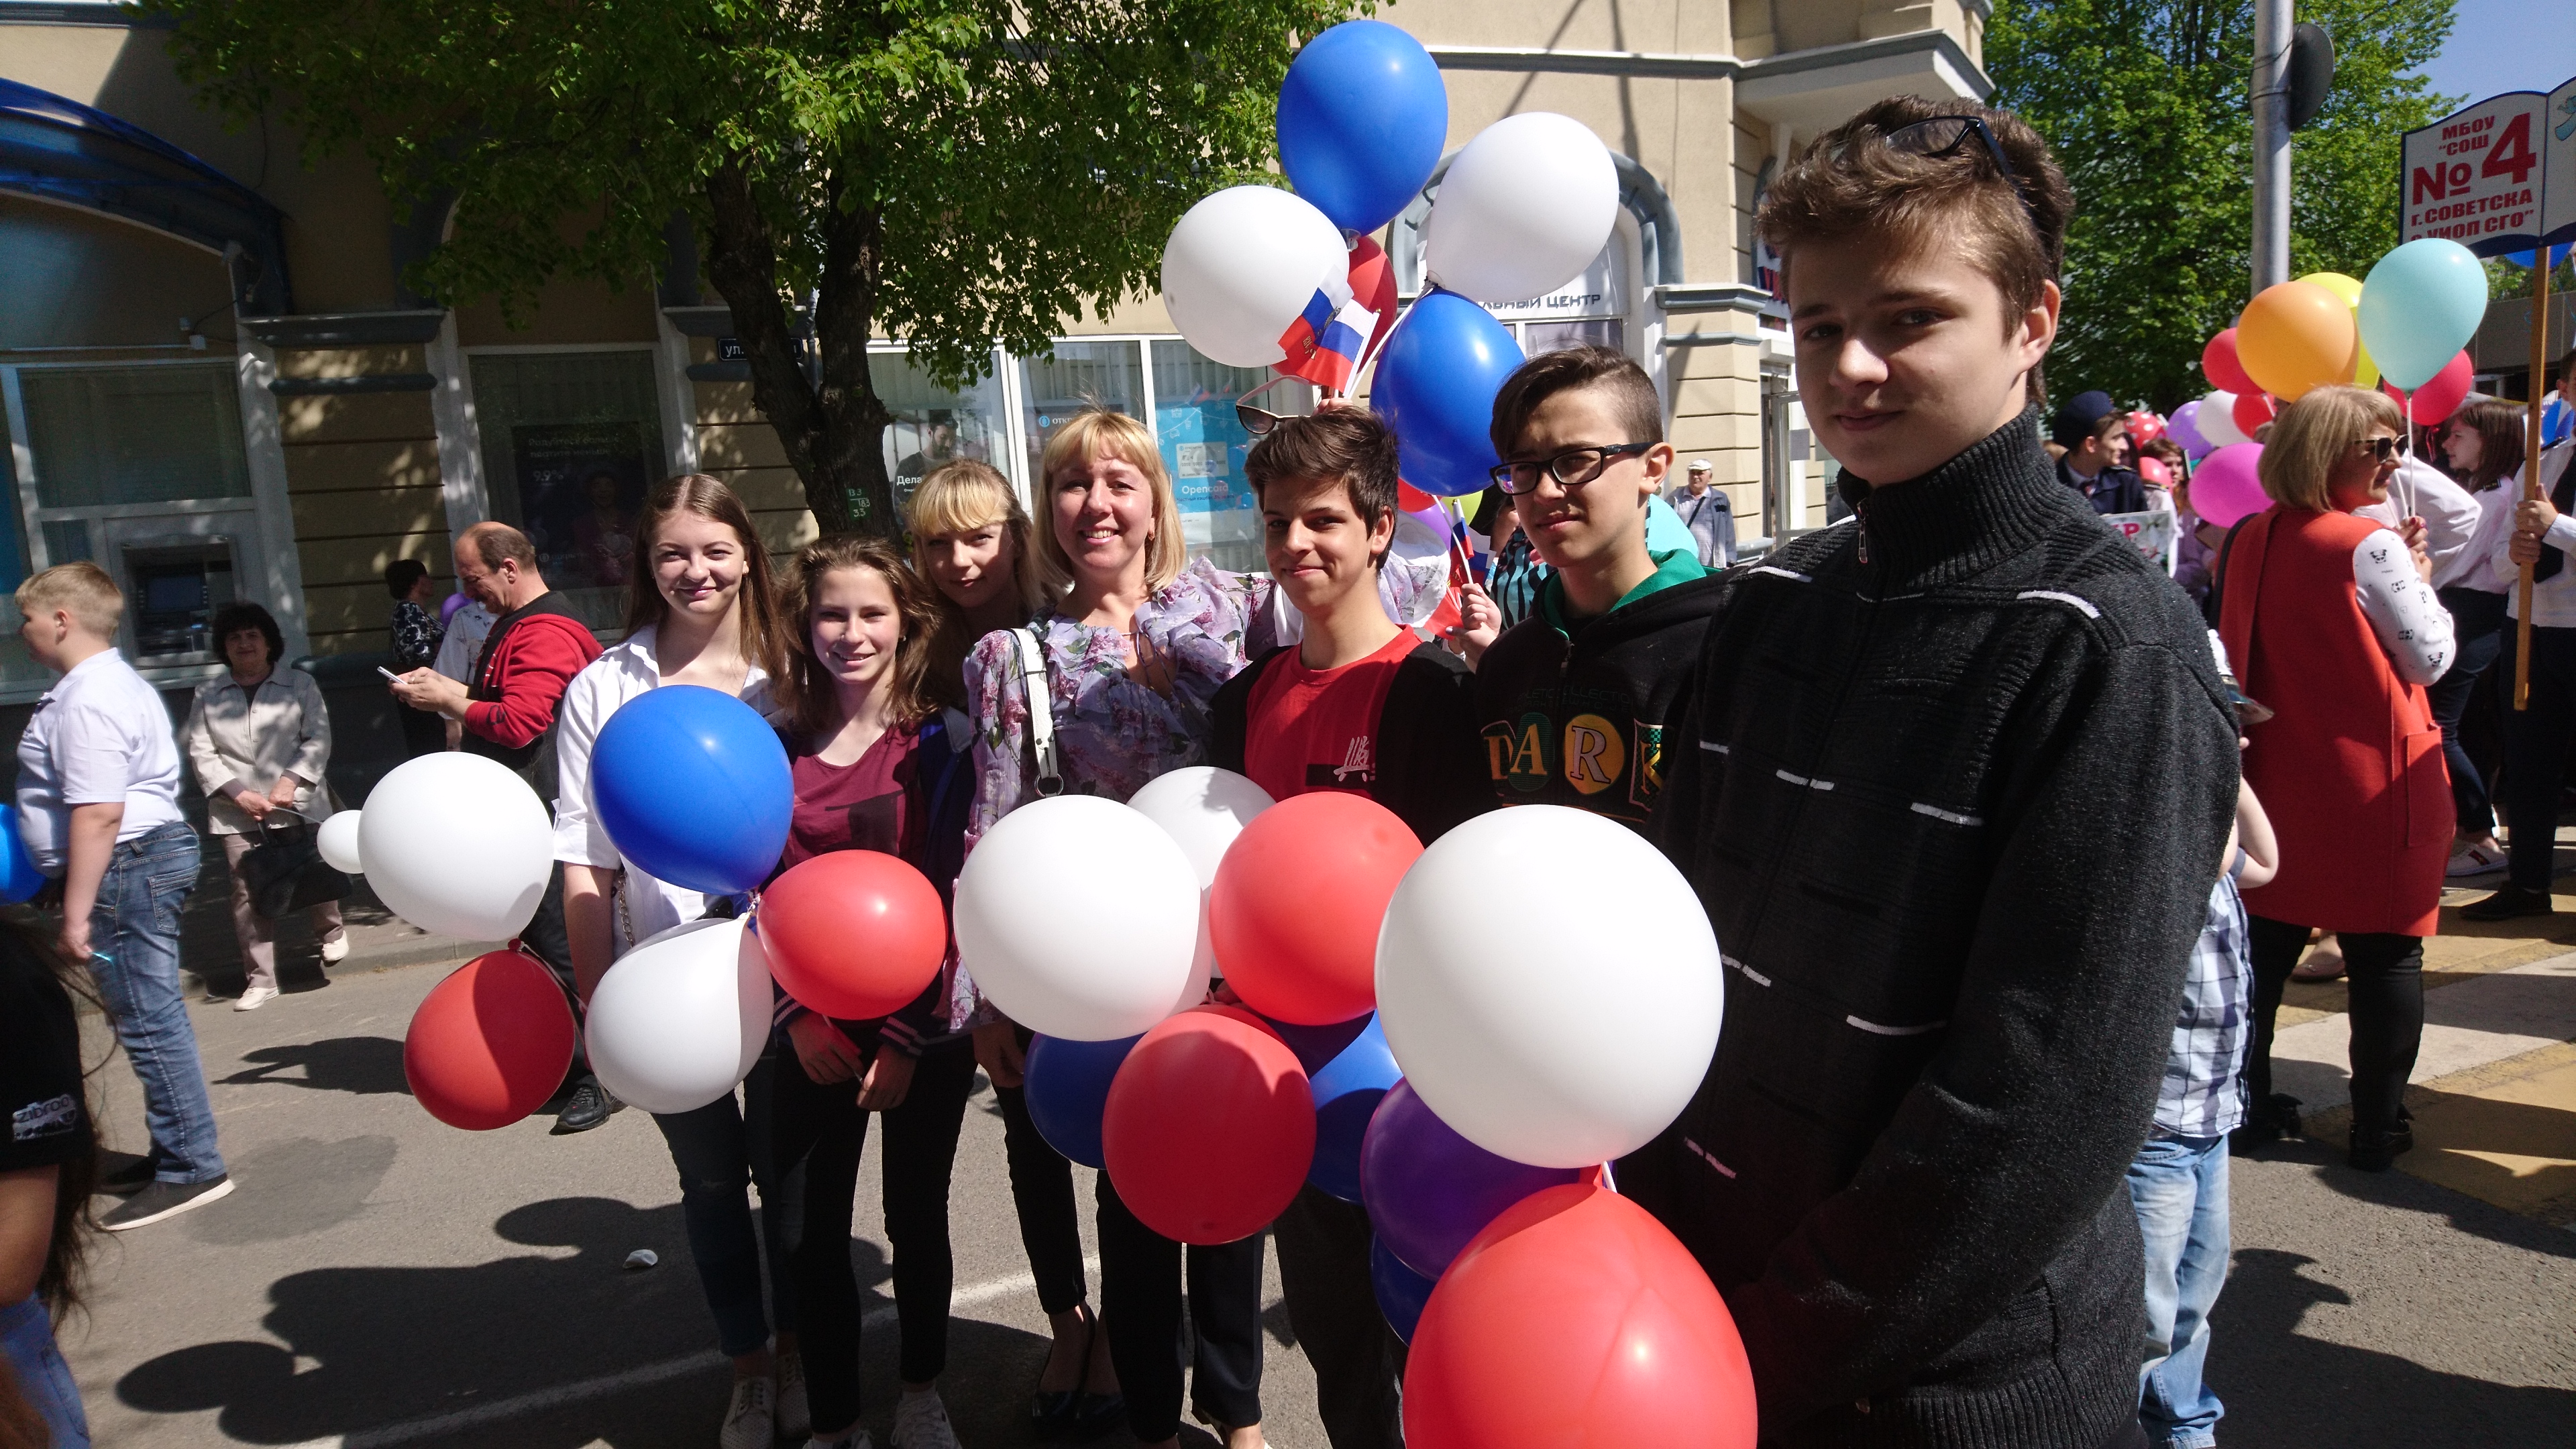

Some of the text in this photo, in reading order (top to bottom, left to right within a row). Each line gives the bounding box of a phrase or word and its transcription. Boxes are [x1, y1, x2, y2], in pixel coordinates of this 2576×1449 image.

[2442, 115, 2495, 141] МБОУ
[2481, 112, 2537, 184] 4
[1546, 294, 1601, 309] ЦЕНТР
[725, 345, 744, 358] ул.
[1181, 484, 1228, 496] Opencard
[853, 508, 866, 517] 3.3
[1483, 723, 1665, 795] DARK
